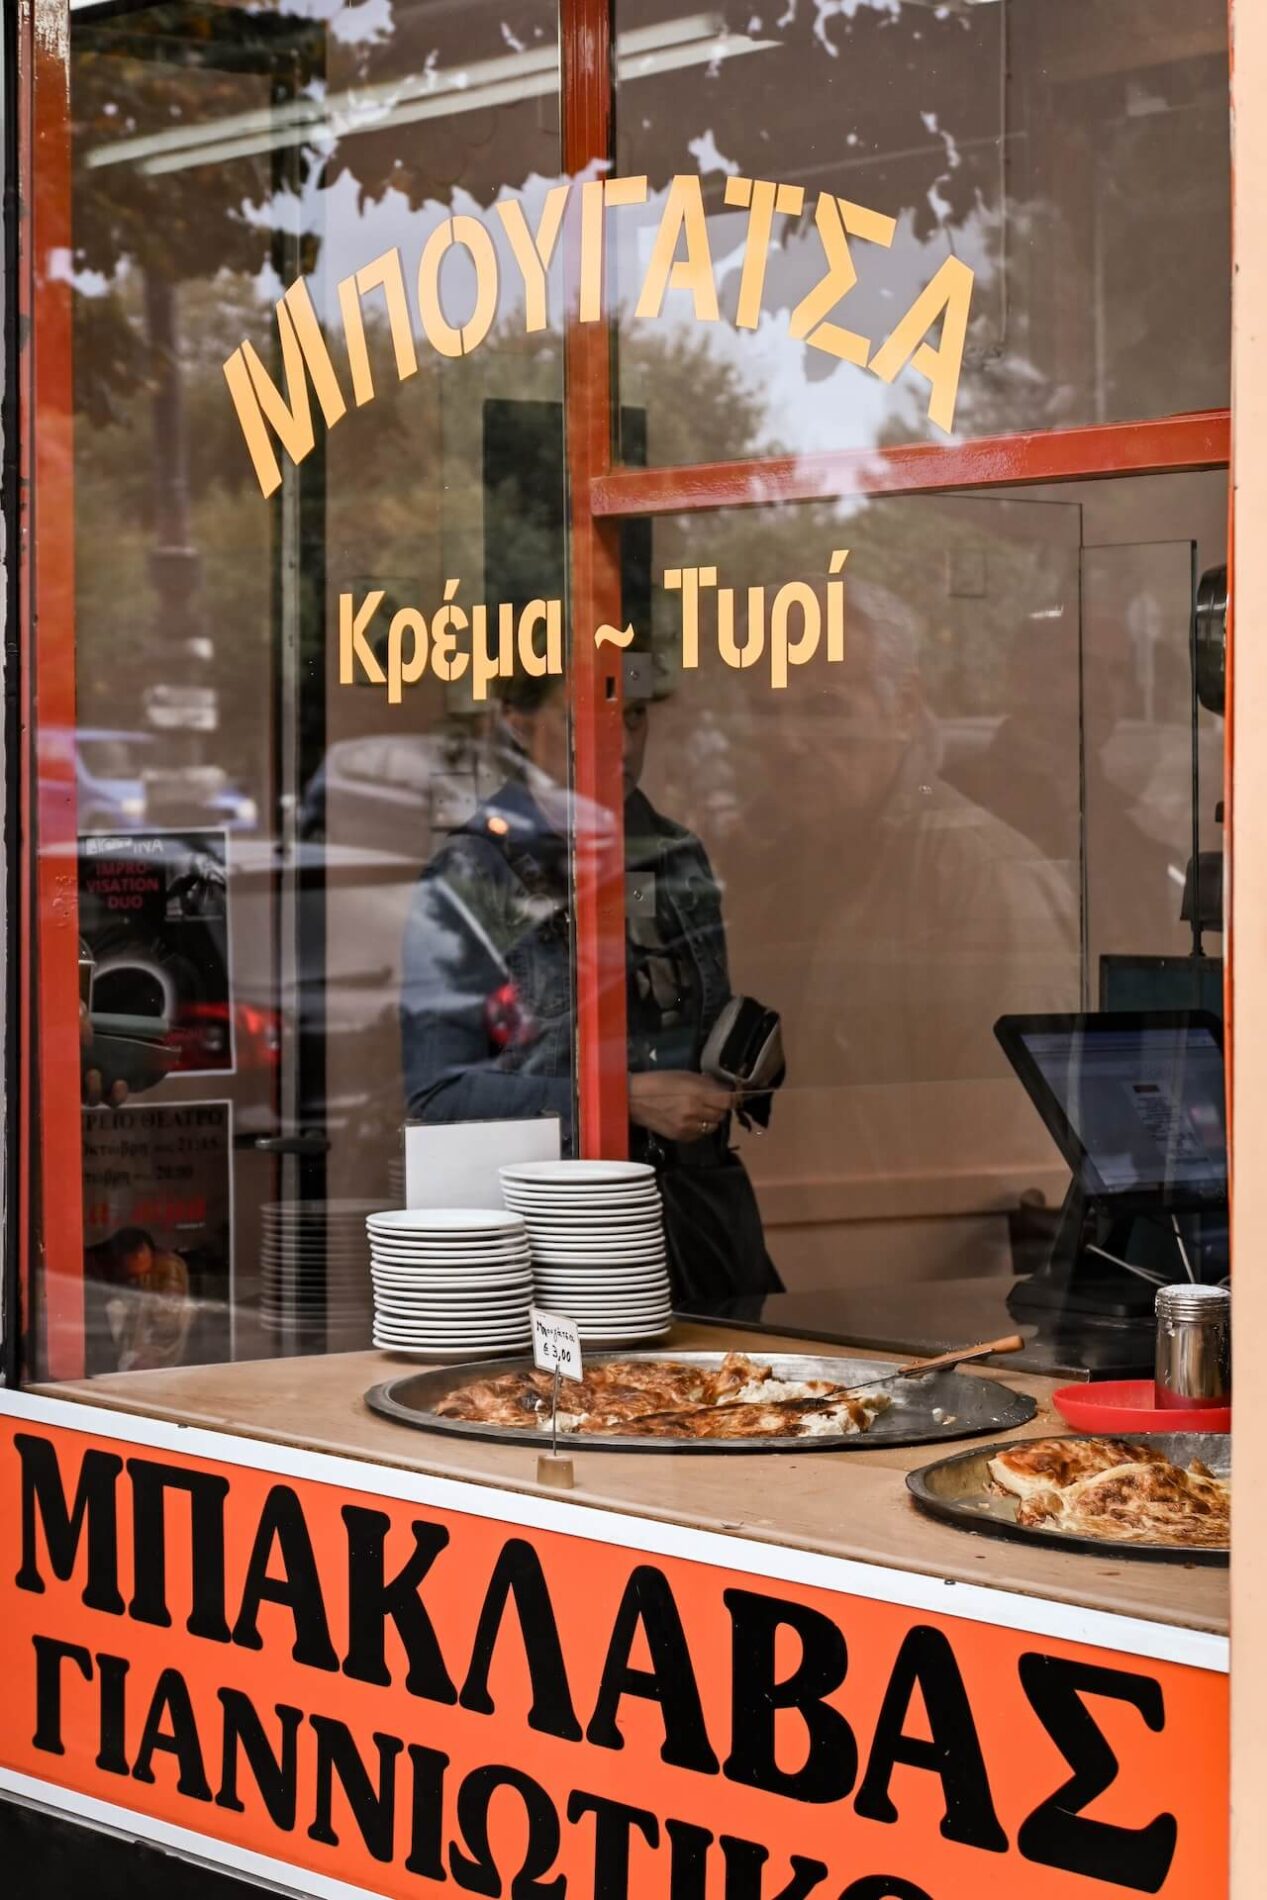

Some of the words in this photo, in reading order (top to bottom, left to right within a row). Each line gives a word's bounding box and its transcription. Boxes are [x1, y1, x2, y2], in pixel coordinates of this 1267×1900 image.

[223, 174, 974, 499] ΜΠΟΥΓΑΤΣΑ
[339, 579, 563, 704] Κρέμα
[664, 549, 849, 689] Τυρί
[86, 877, 160, 893] VISATION
[107, 895, 143, 909] DUO
[15, 1434, 1177, 1894] ΜΠΑΚΛΑΒΑΣ
[32, 1636, 933, 1900] ΓΙΑΝΝΙΩΤΙ
